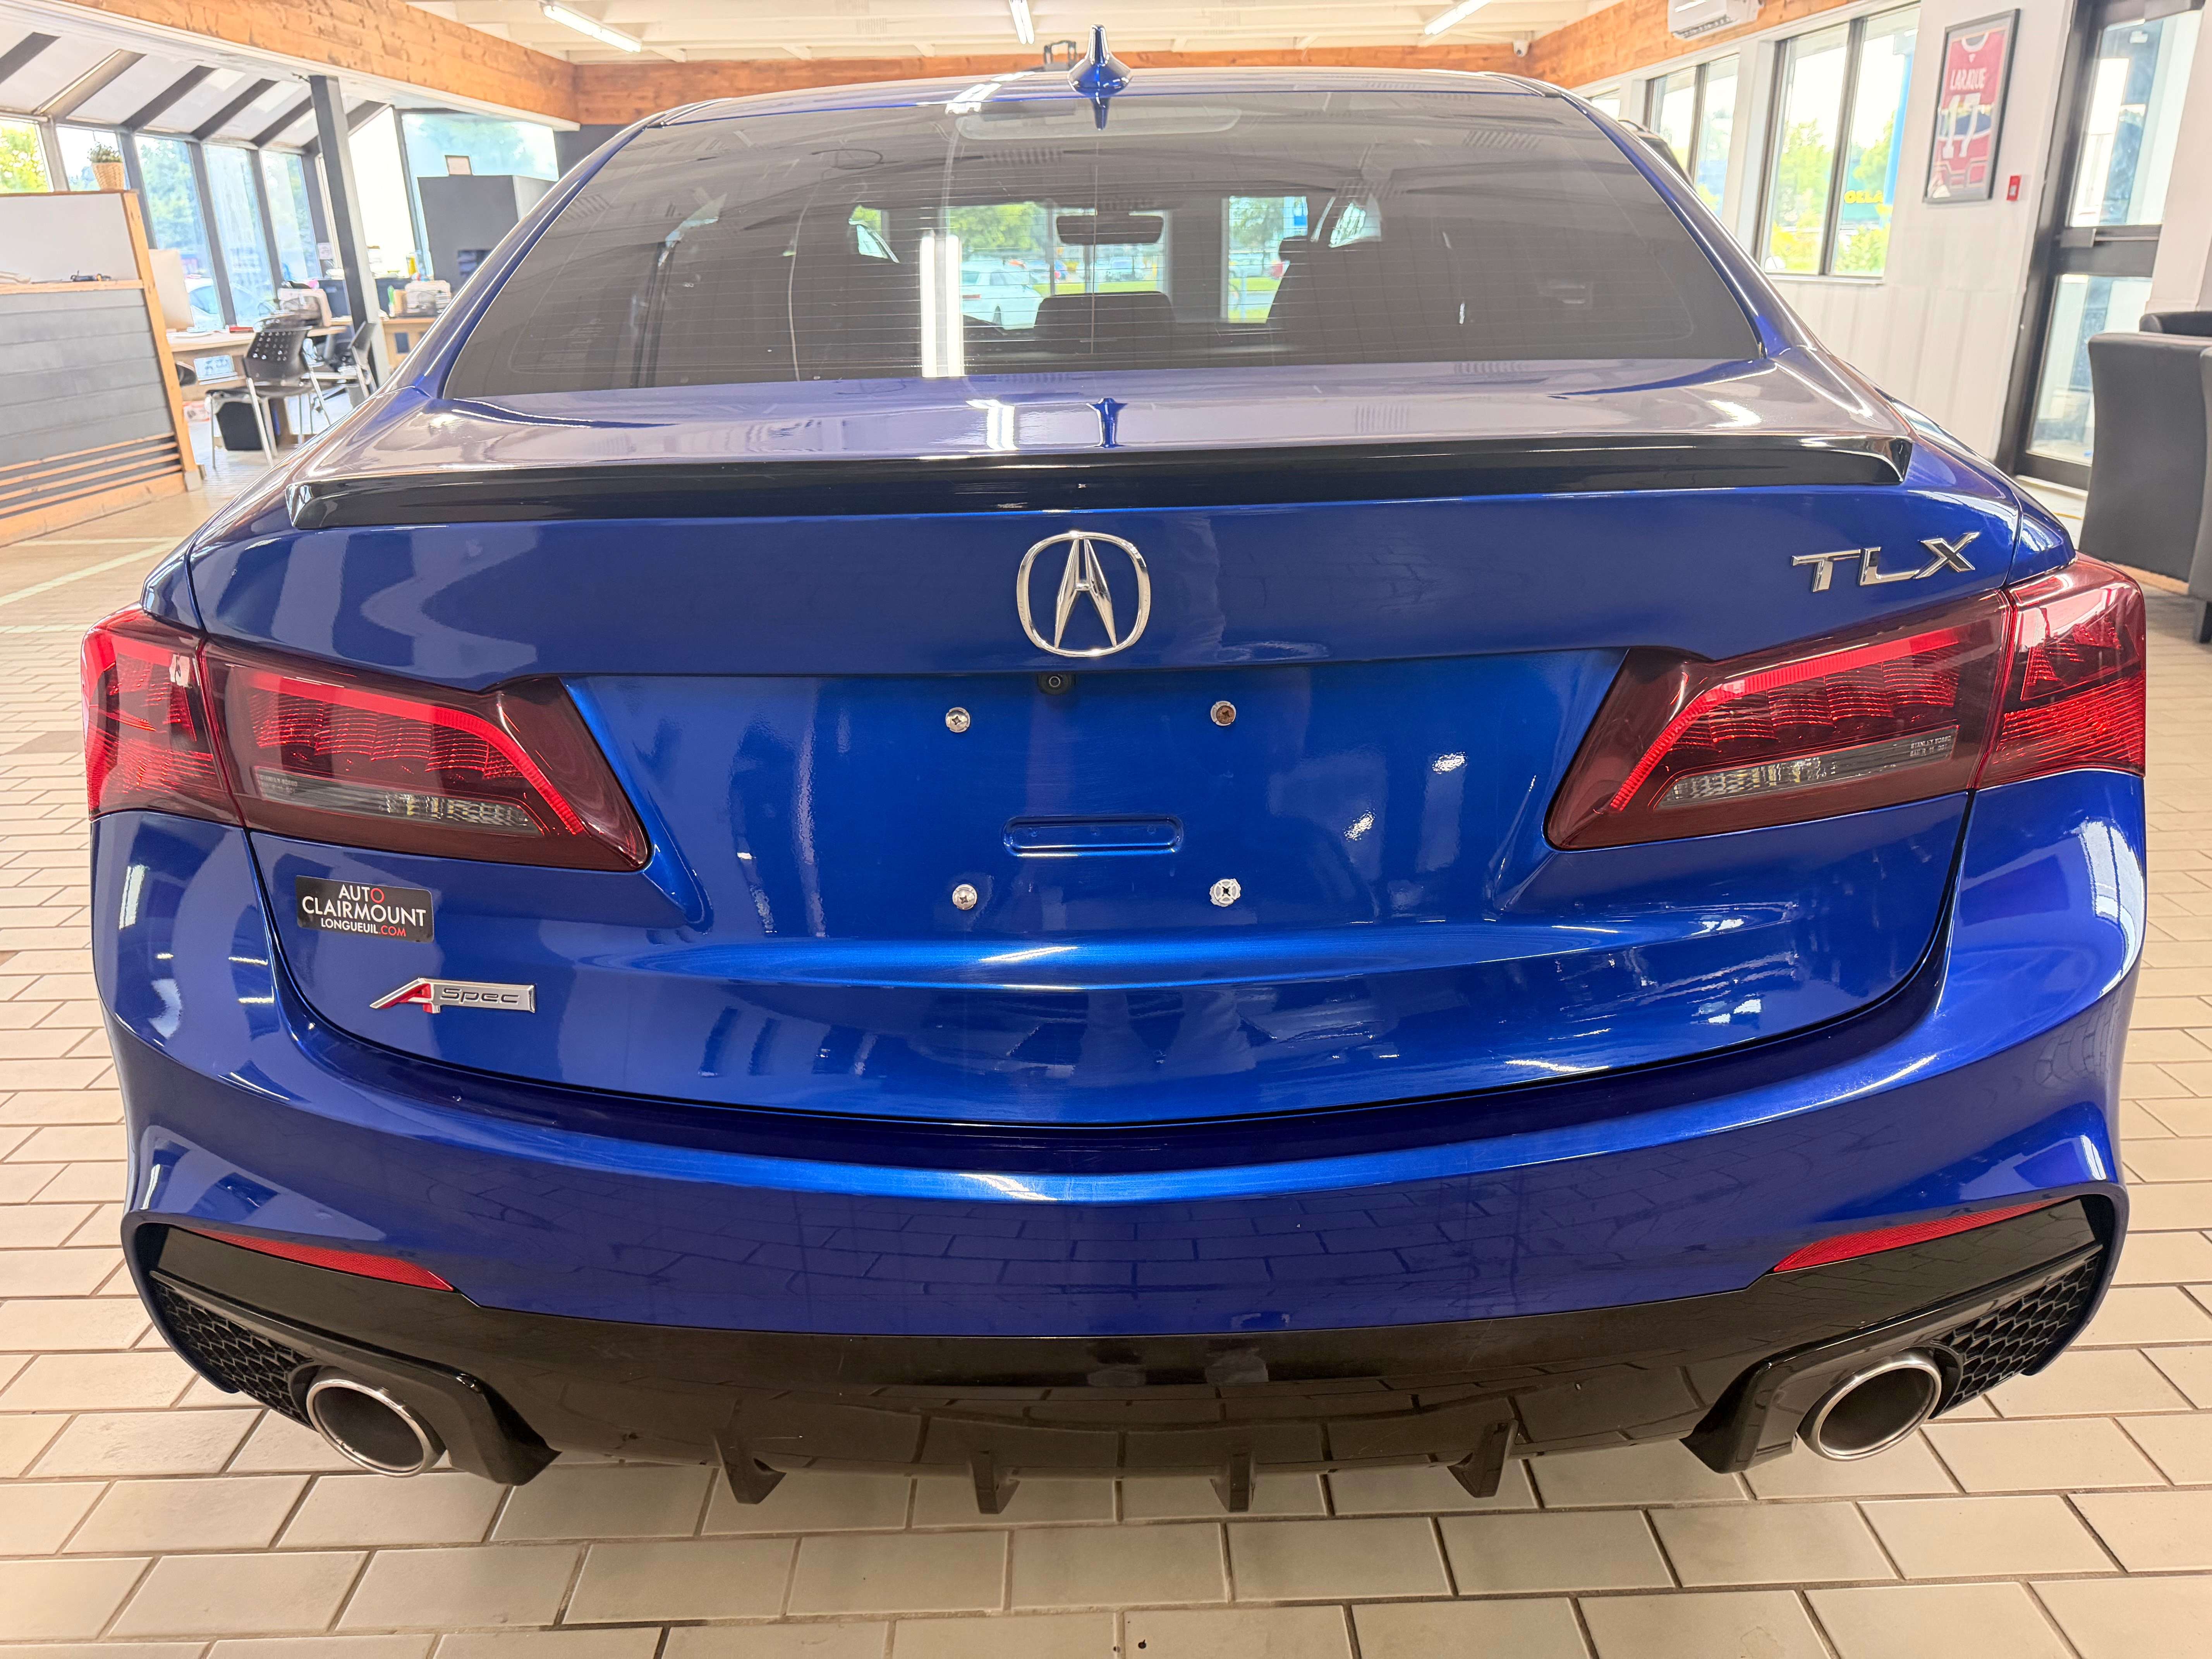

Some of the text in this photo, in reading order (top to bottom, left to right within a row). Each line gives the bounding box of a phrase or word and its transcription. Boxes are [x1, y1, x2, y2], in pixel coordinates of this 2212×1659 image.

[1942, 92, 1981, 159] 17
[1791, 532, 1980, 592] TLX
[1911, 739, 1934, 749] STANLEY
[338, 884, 385, 904] AUTO
[302, 896, 426, 927] CLAIRMOUNT
[321, 917, 406, 937] LONGUEUIL.COM
